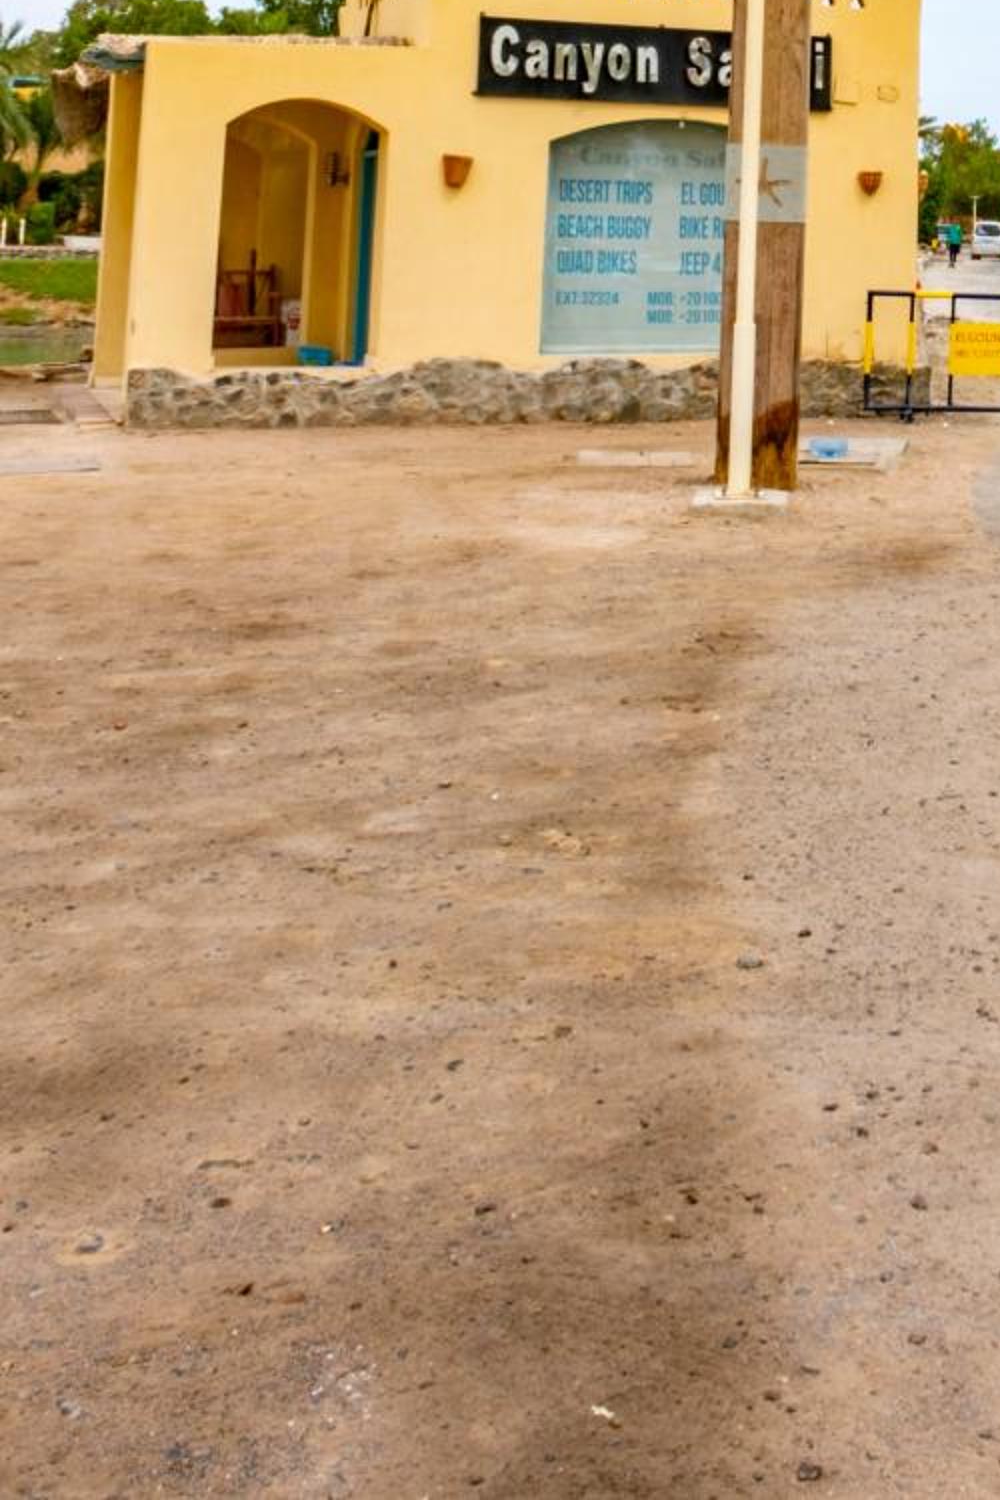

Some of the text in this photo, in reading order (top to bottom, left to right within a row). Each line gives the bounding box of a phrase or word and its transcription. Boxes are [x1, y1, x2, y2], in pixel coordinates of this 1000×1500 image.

[490, 25, 825, 93] Canyon Sai
[559, 179, 653, 204] DESERT TRIPS
[681, 181, 697, 205] EL
[557, 213, 651, 239] BEACH BUGGY
[679, 216, 709, 239] BIKE
[556, 250, 637, 274] QUAD BIKES
[680, 252, 710, 275] JEEP
